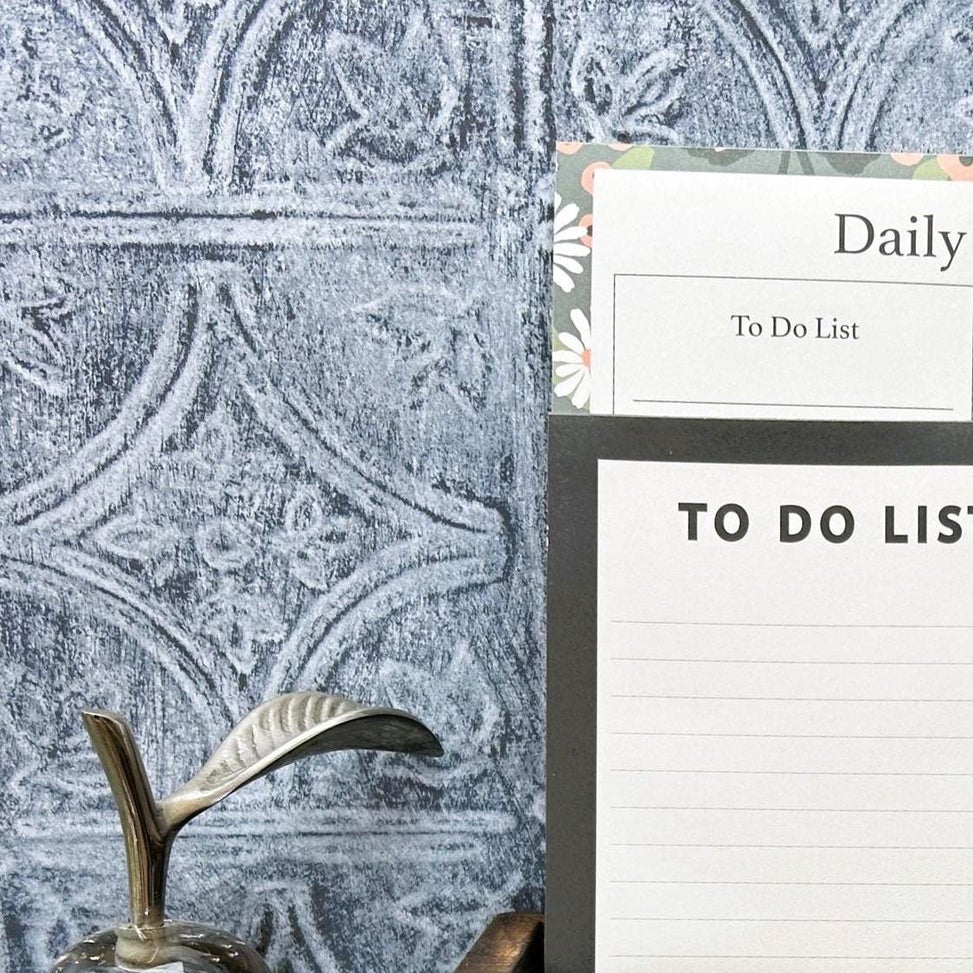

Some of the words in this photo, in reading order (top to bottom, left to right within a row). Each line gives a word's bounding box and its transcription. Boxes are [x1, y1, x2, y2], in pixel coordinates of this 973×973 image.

[835, 212, 966, 272] Daily
[731, 315, 762, 338] To
[769, 315, 808, 339] Do
[814, 316, 860, 341] List
[678, 502, 750, 543] TO
[781, 504, 856, 545] DO
